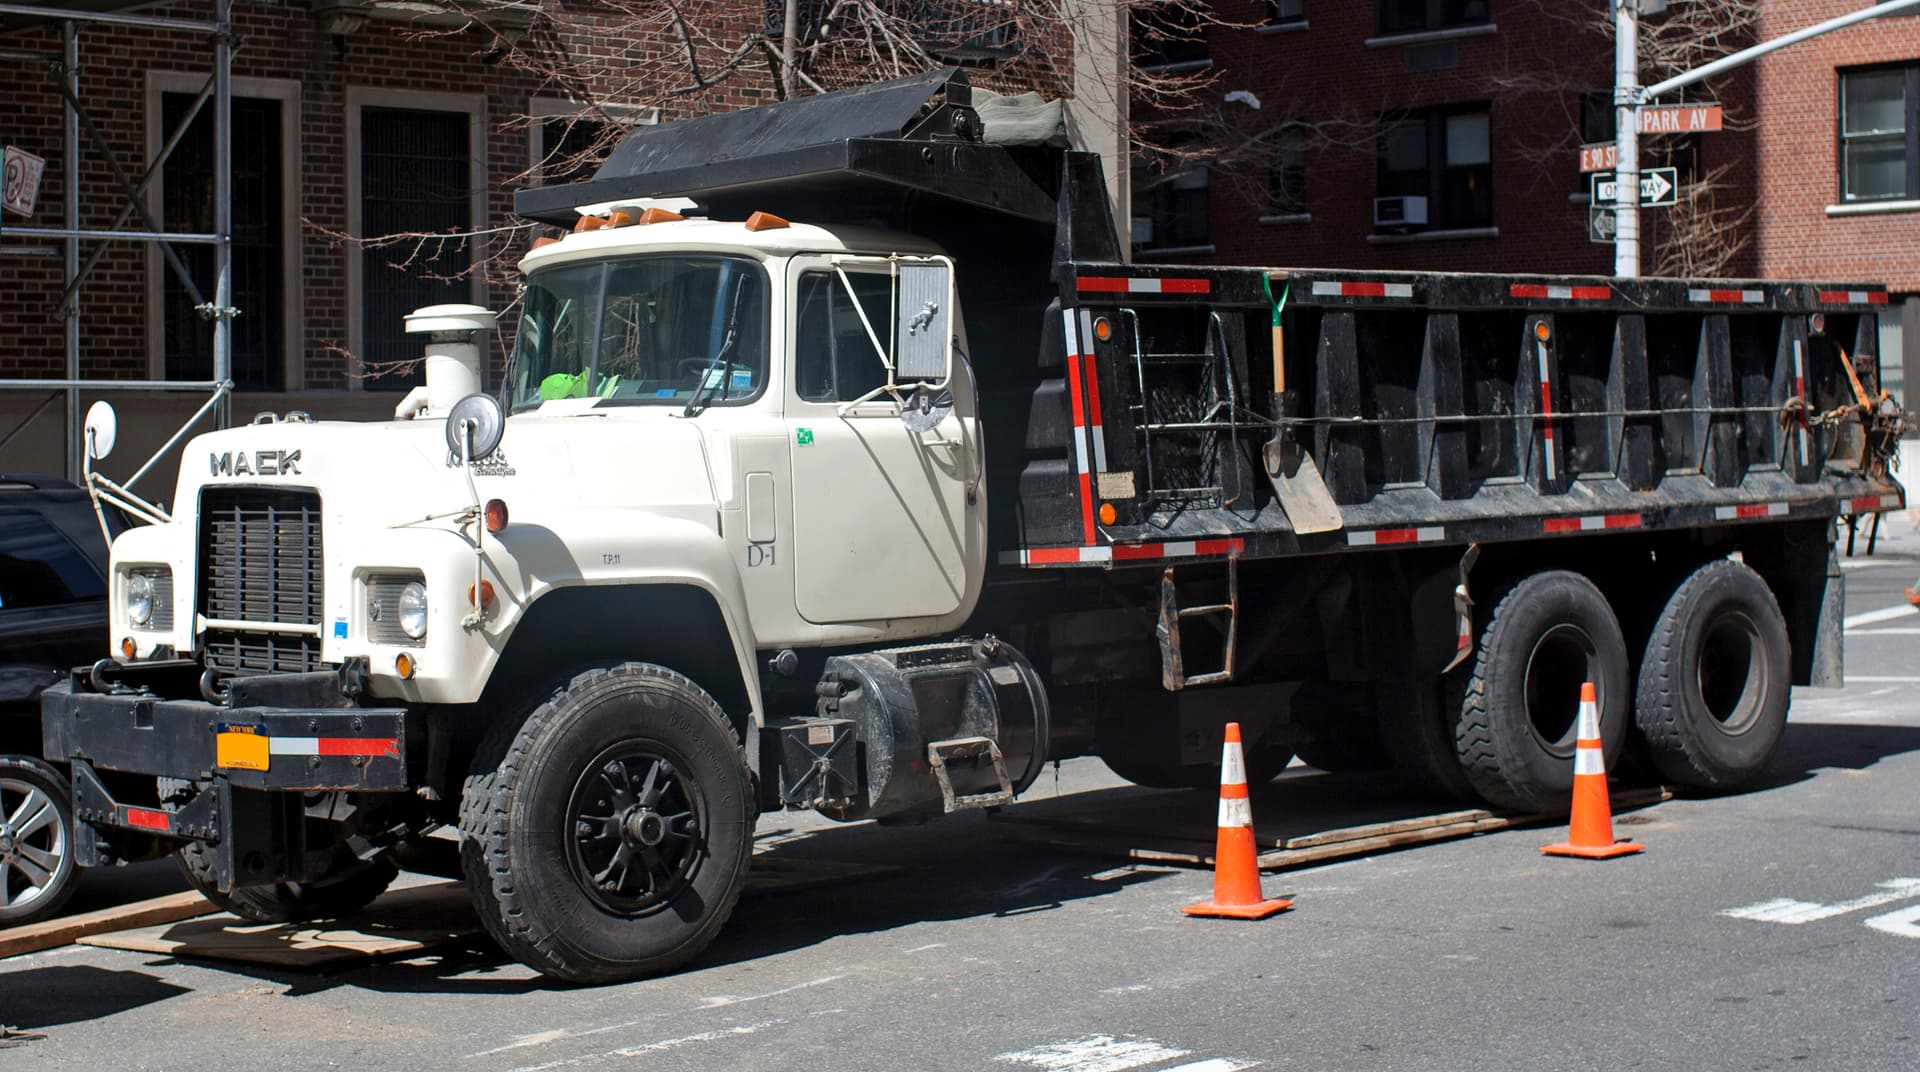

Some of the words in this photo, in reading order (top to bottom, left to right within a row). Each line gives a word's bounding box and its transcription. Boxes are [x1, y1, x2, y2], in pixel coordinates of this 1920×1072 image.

[1644, 110, 1680, 132] PARK
[1690, 108, 1707, 129] AV
[1583, 150, 1589, 170] E
[1591, 148, 1603, 169] 90
[210, 449, 302, 477] MACK
[748, 544, 776, 567] D-1
